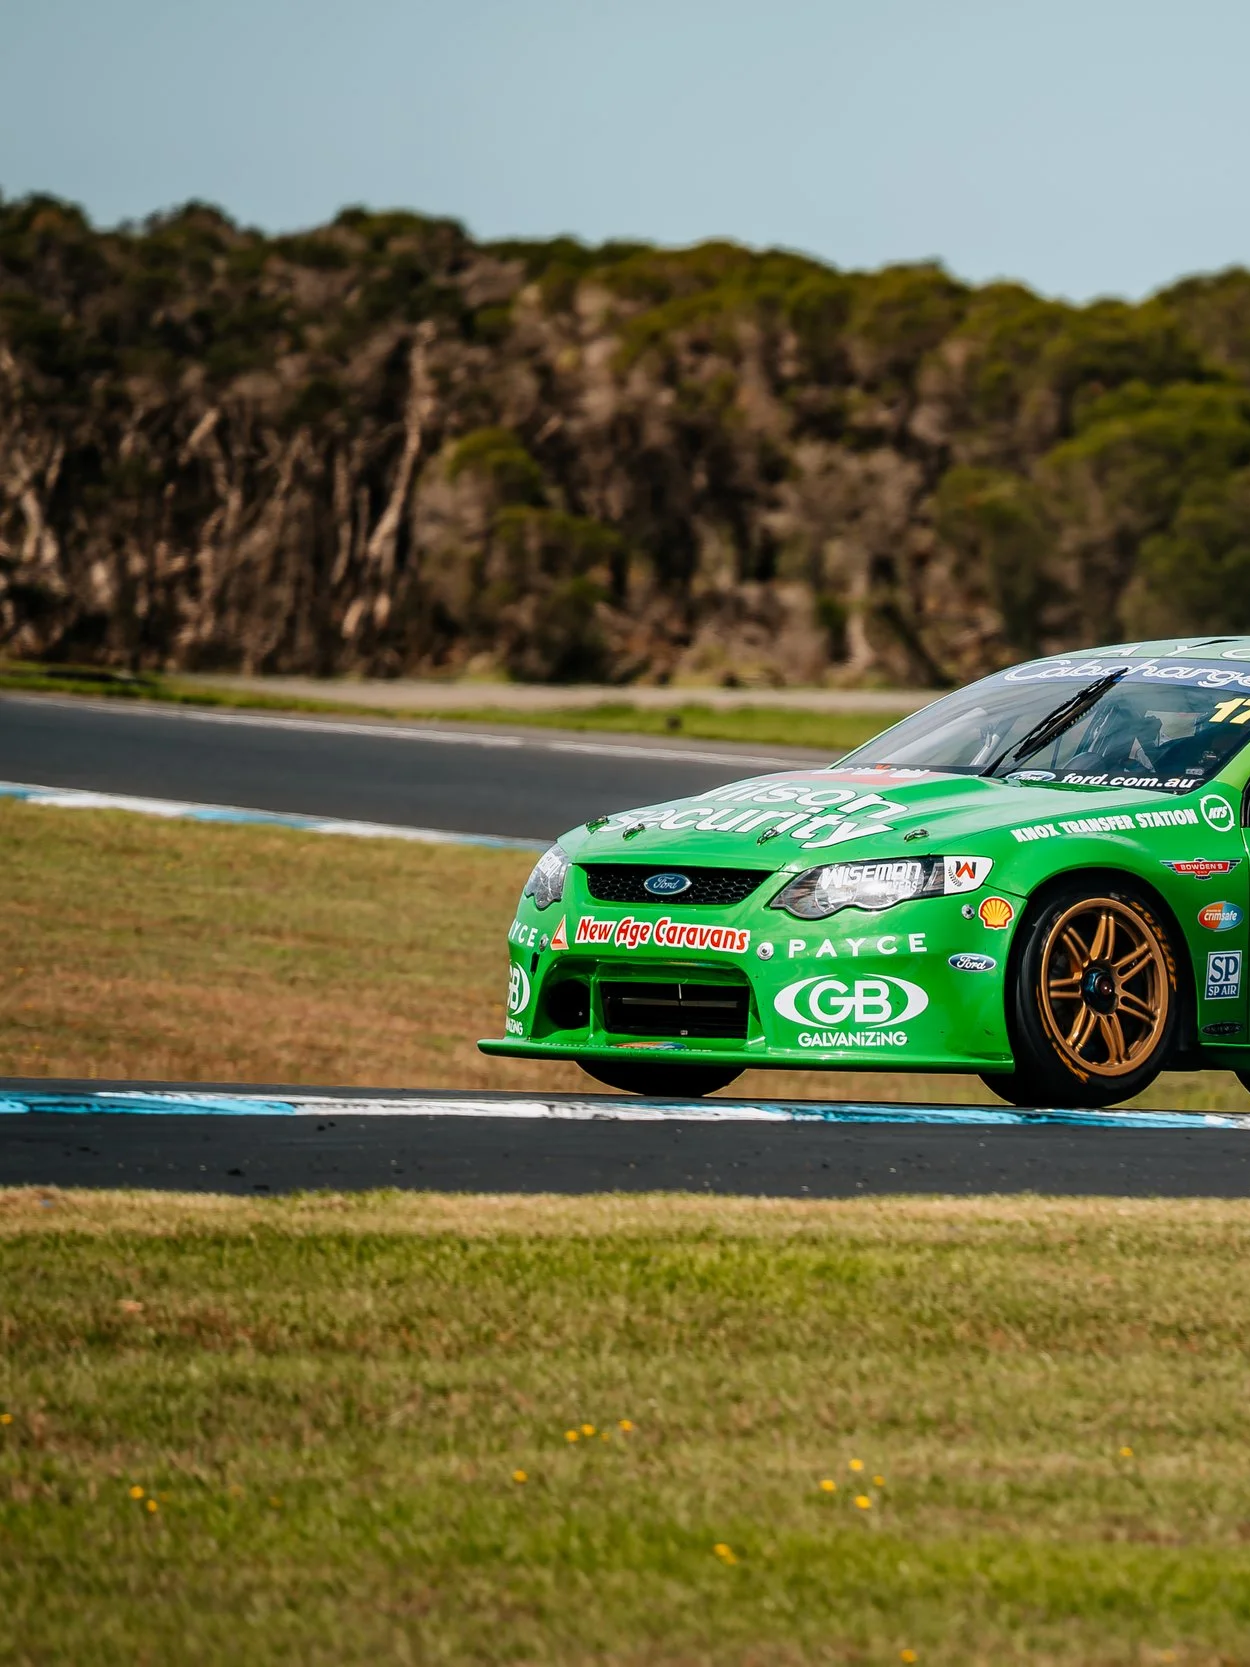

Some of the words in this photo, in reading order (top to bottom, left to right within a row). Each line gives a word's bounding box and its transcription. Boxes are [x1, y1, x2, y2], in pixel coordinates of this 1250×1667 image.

[1061, 772, 1197, 789] ford.com.au
[1208, 805, 1228, 820] KTS
[1010, 822, 1062, 843] KNOX
[1058, 814, 1137, 835] TRANSFER
[1134, 808, 1200, 829] STATION
[1179, 863, 1224, 871] BOWDEN'S
[652, 876, 681, 889] Ford
[1203, 909, 1238, 921] crimsafe
[576, 917, 614, 942] New
[615, 918, 651, 947] Age
[655, 919, 748, 951] Caravans
[787, 932, 928, 959] PAYCE
[955, 956, 987, 970] Ford
[1209, 955, 1240, 984] SP
[1207, 985, 1220, 996] SP
[1221, 984, 1237, 996] AIR
[808, 979, 893, 1024] GB
